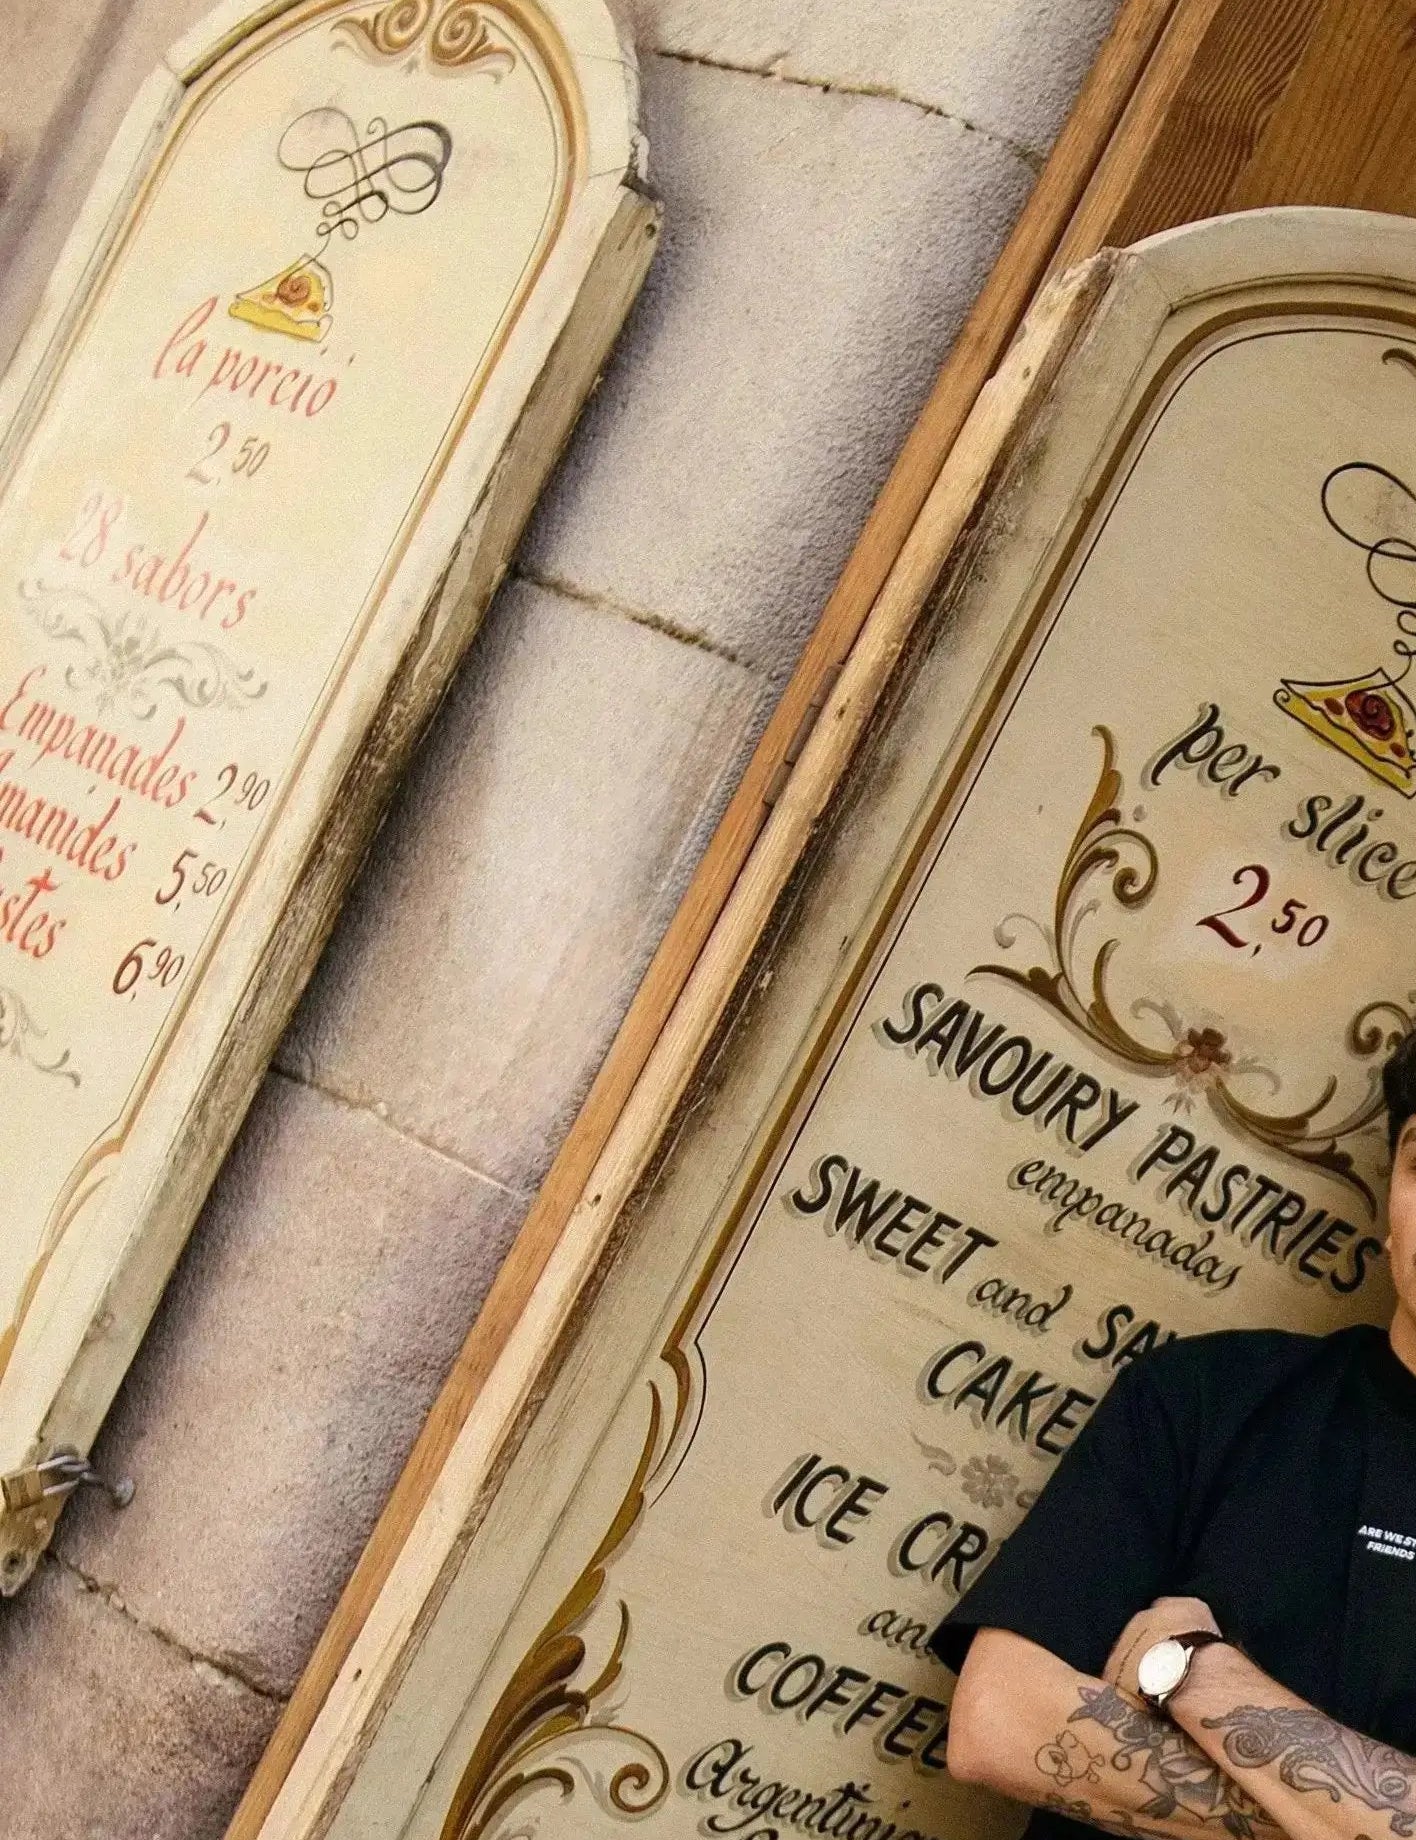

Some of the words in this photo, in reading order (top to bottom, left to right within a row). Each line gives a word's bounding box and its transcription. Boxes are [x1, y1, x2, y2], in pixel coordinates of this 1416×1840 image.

[152, 296, 219, 380] la
[190, 346, 357, 417] porció
[184, 421, 271, 486] 2,50
[57, 492, 124, 569] 28
[112, 510, 257, 630] sabors
[0, 664, 198, 809] Empanades
[194, 763, 272, 831] 2,90
[1149, 703, 1281, 797] per
[156, 848, 227, 912] 5,50
[1195, 864, 1330, 958] 2,50
[112, 937, 186, 1001] 6,90
[882, 982, 1140, 1154] SAVOURY
[1134, 1122, 1386, 1295] PASTRIES
[791, 1154, 1000, 1285] SWEET
[975, 1282, 1074, 1333] and
[1014, 1155, 1245, 1291] empanadas
[773, 1453, 890, 1545] ICE
[1358, 1525, 1383, 1538] ARE
[1384, 1530, 1404, 1545] WE
[1367, 1541, 1415, 1560] FRIENDS
[867, 1609, 936, 1656] an
